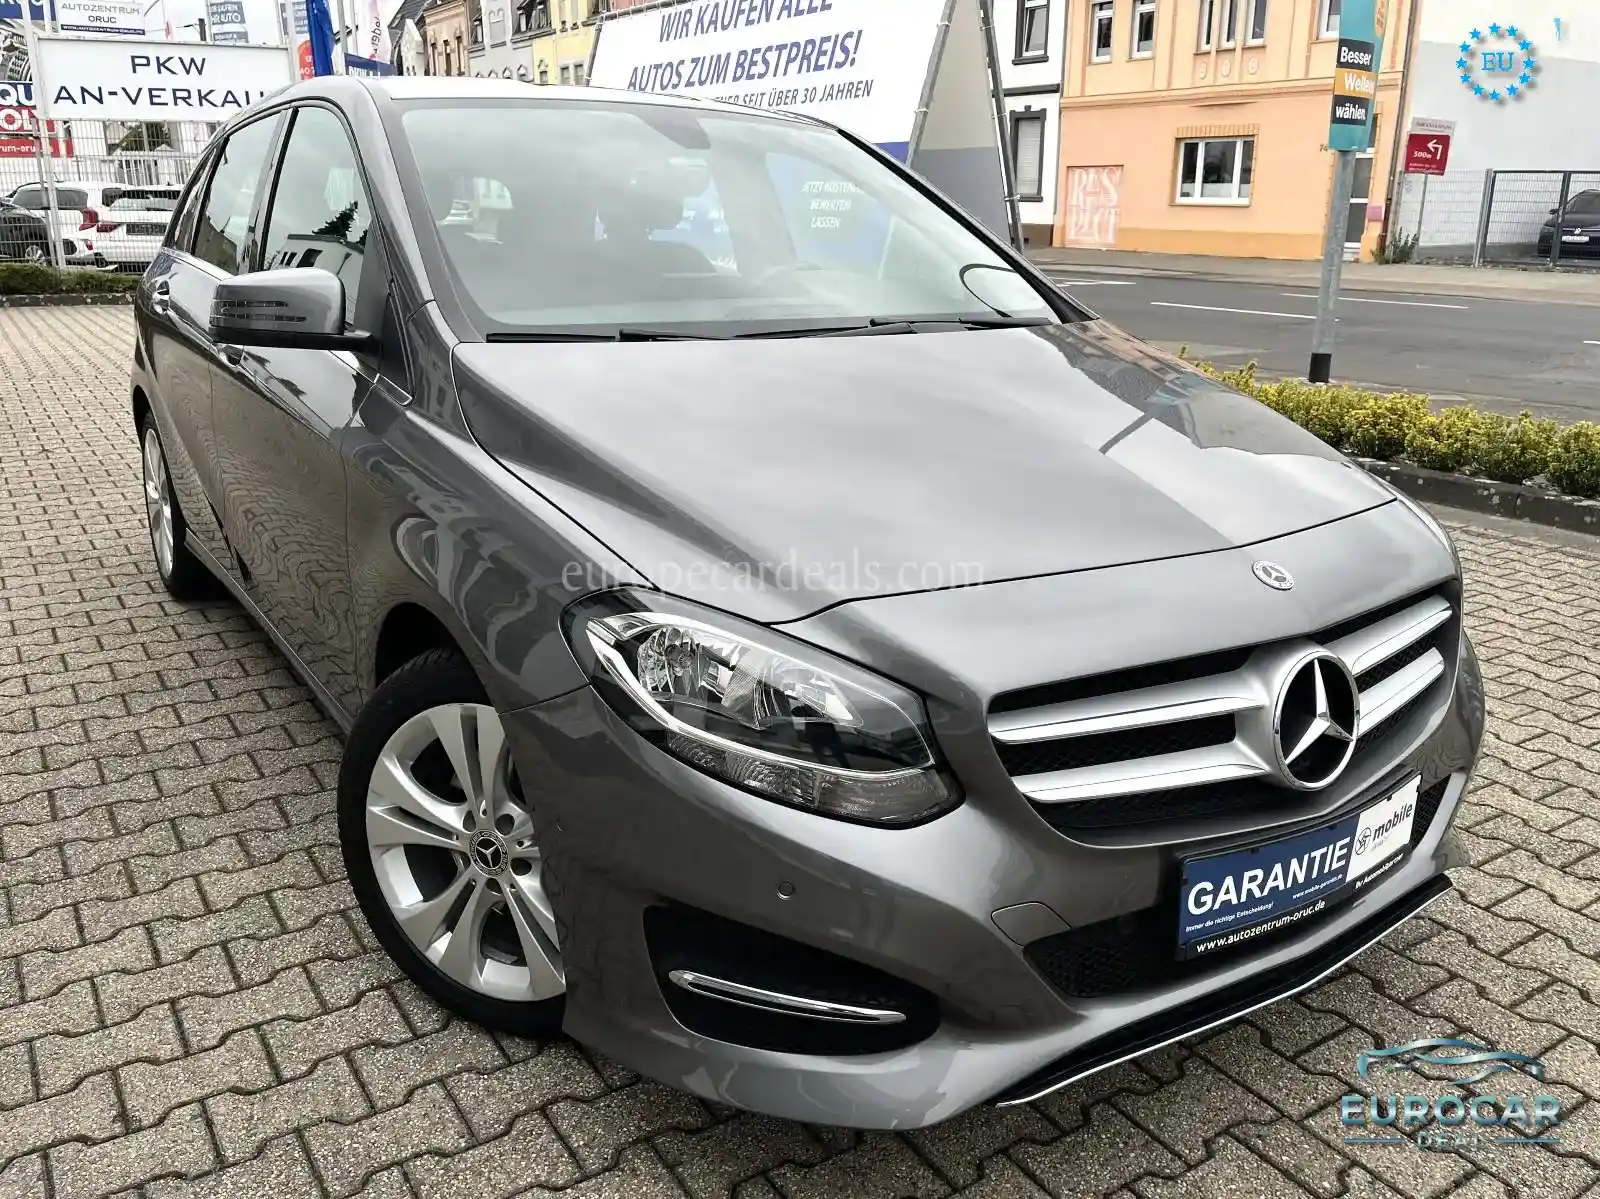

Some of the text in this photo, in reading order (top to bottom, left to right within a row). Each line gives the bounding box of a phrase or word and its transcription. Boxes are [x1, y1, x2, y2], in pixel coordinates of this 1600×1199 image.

[61, 3, 140, 15] AUTOZENTRUM
[88, 15, 117, 24] ORUC
[659, 9, 692, 43] WIR
[693, 0, 775, 36] KAUFEN
[130, 55, 206, 76] PKW
[627, 29, 863, 92] AUTOS ZUM BESTPREIS!
[1340, 46, 1372, 66] Besser
[53, 85, 264, 108] AN-VERKA
[768, 88, 799, 107] ÜBER
[801, 87, 817, 104] 30
[818, 79, 874, 103] JAHREN
[1373, 803, 1413, 840] mobile
[1187, 837, 1351, 916] GARANTIE
[1185, 901, 1274, 933] Immer die richtige Entscheidung!
[1196, 900, 1326, 953] www.autozentrum-oruc.de
